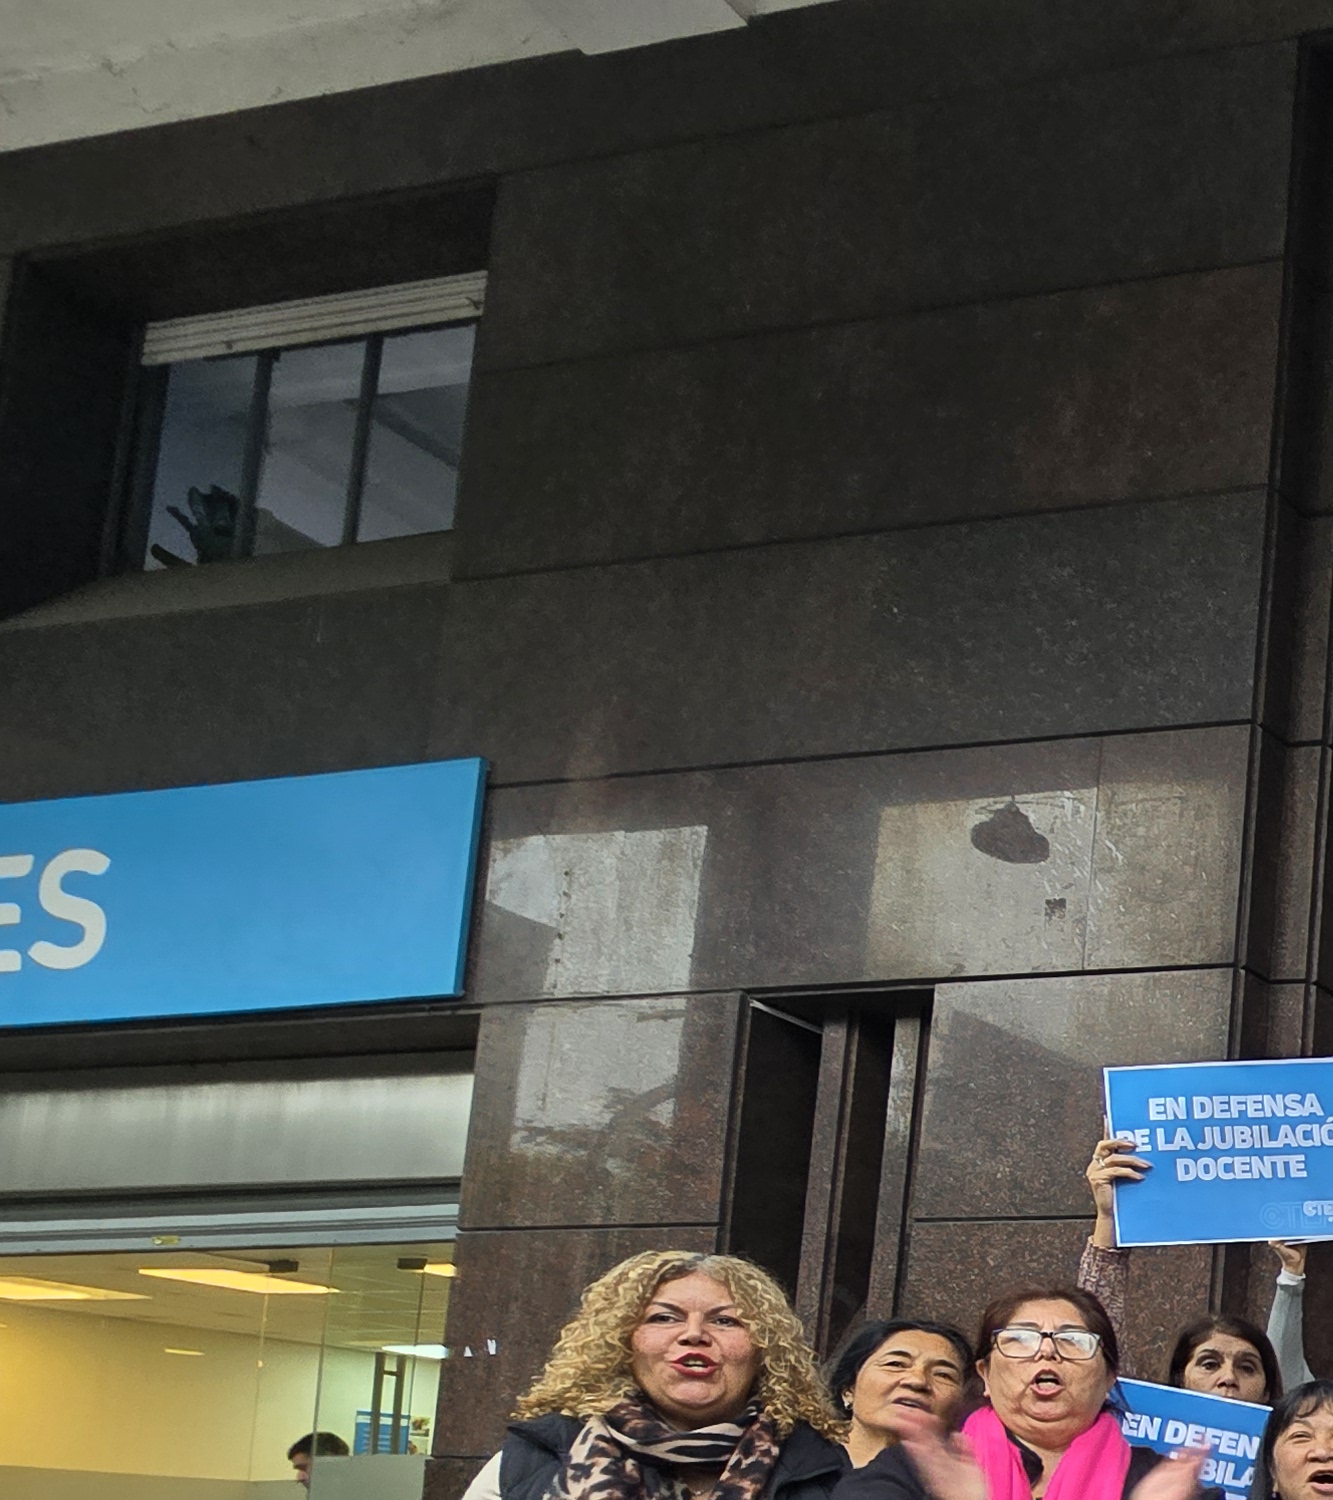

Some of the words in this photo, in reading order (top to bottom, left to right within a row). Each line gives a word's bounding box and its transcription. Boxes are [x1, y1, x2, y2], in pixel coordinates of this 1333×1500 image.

[1148, 1096, 1185, 1121] EN
[1192, 1093, 1324, 1121] DEFENSA
[1156, 1127, 1196, 1151] LA
[1176, 1154, 1307, 1182] DOCENTE
[1122, 1411, 1163, 1441] EN
